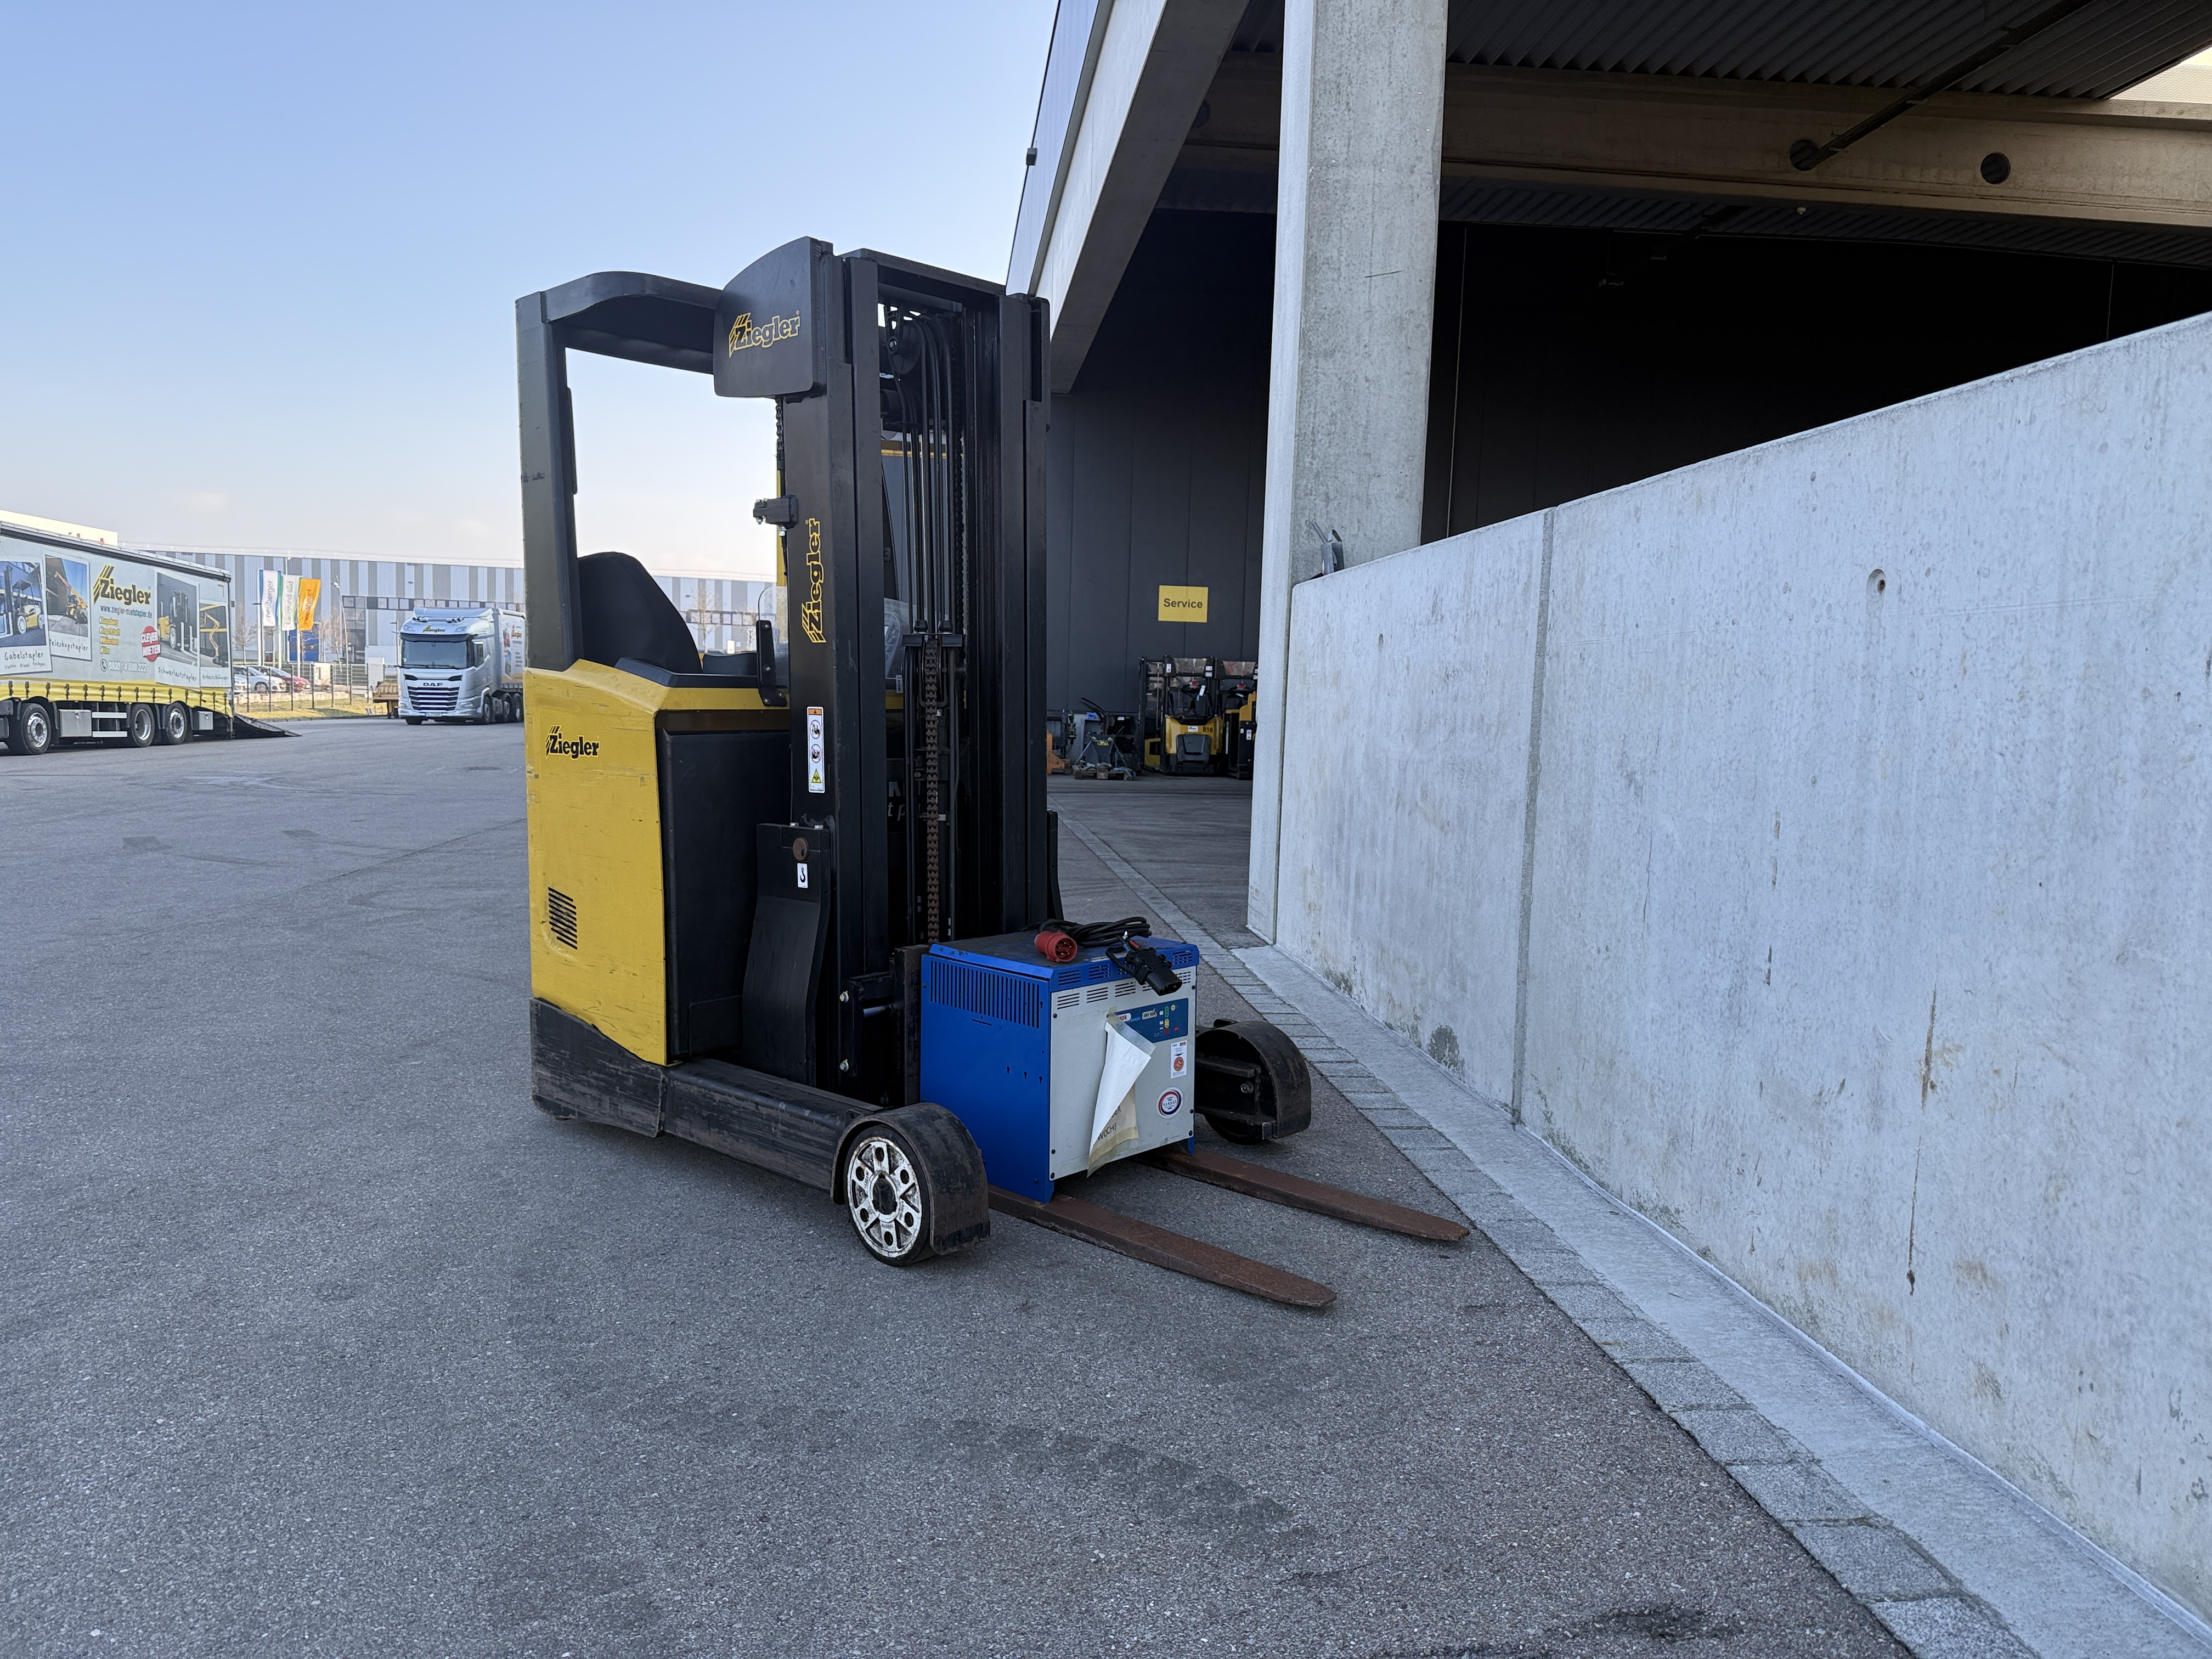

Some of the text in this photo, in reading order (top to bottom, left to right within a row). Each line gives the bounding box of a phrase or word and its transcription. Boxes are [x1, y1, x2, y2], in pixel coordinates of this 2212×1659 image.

[733, 314, 800, 351] Ziegler
[805, 517, 825, 634] Ziegler
[98, 577, 151, 606] Ziegler
[1164, 598, 1203, 608] Service
[140, 631, 159, 644] CLEVER
[4, 650, 44, 661] Gabelstapler
[143, 644, 161, 657] MIETEN
[108, 661, 121, 671] 0800
[138, 663, 148, 673] 222
[158, 666, 197, 683] Schwerlaststapler
[549, 731, 600, 760] Ziegler
